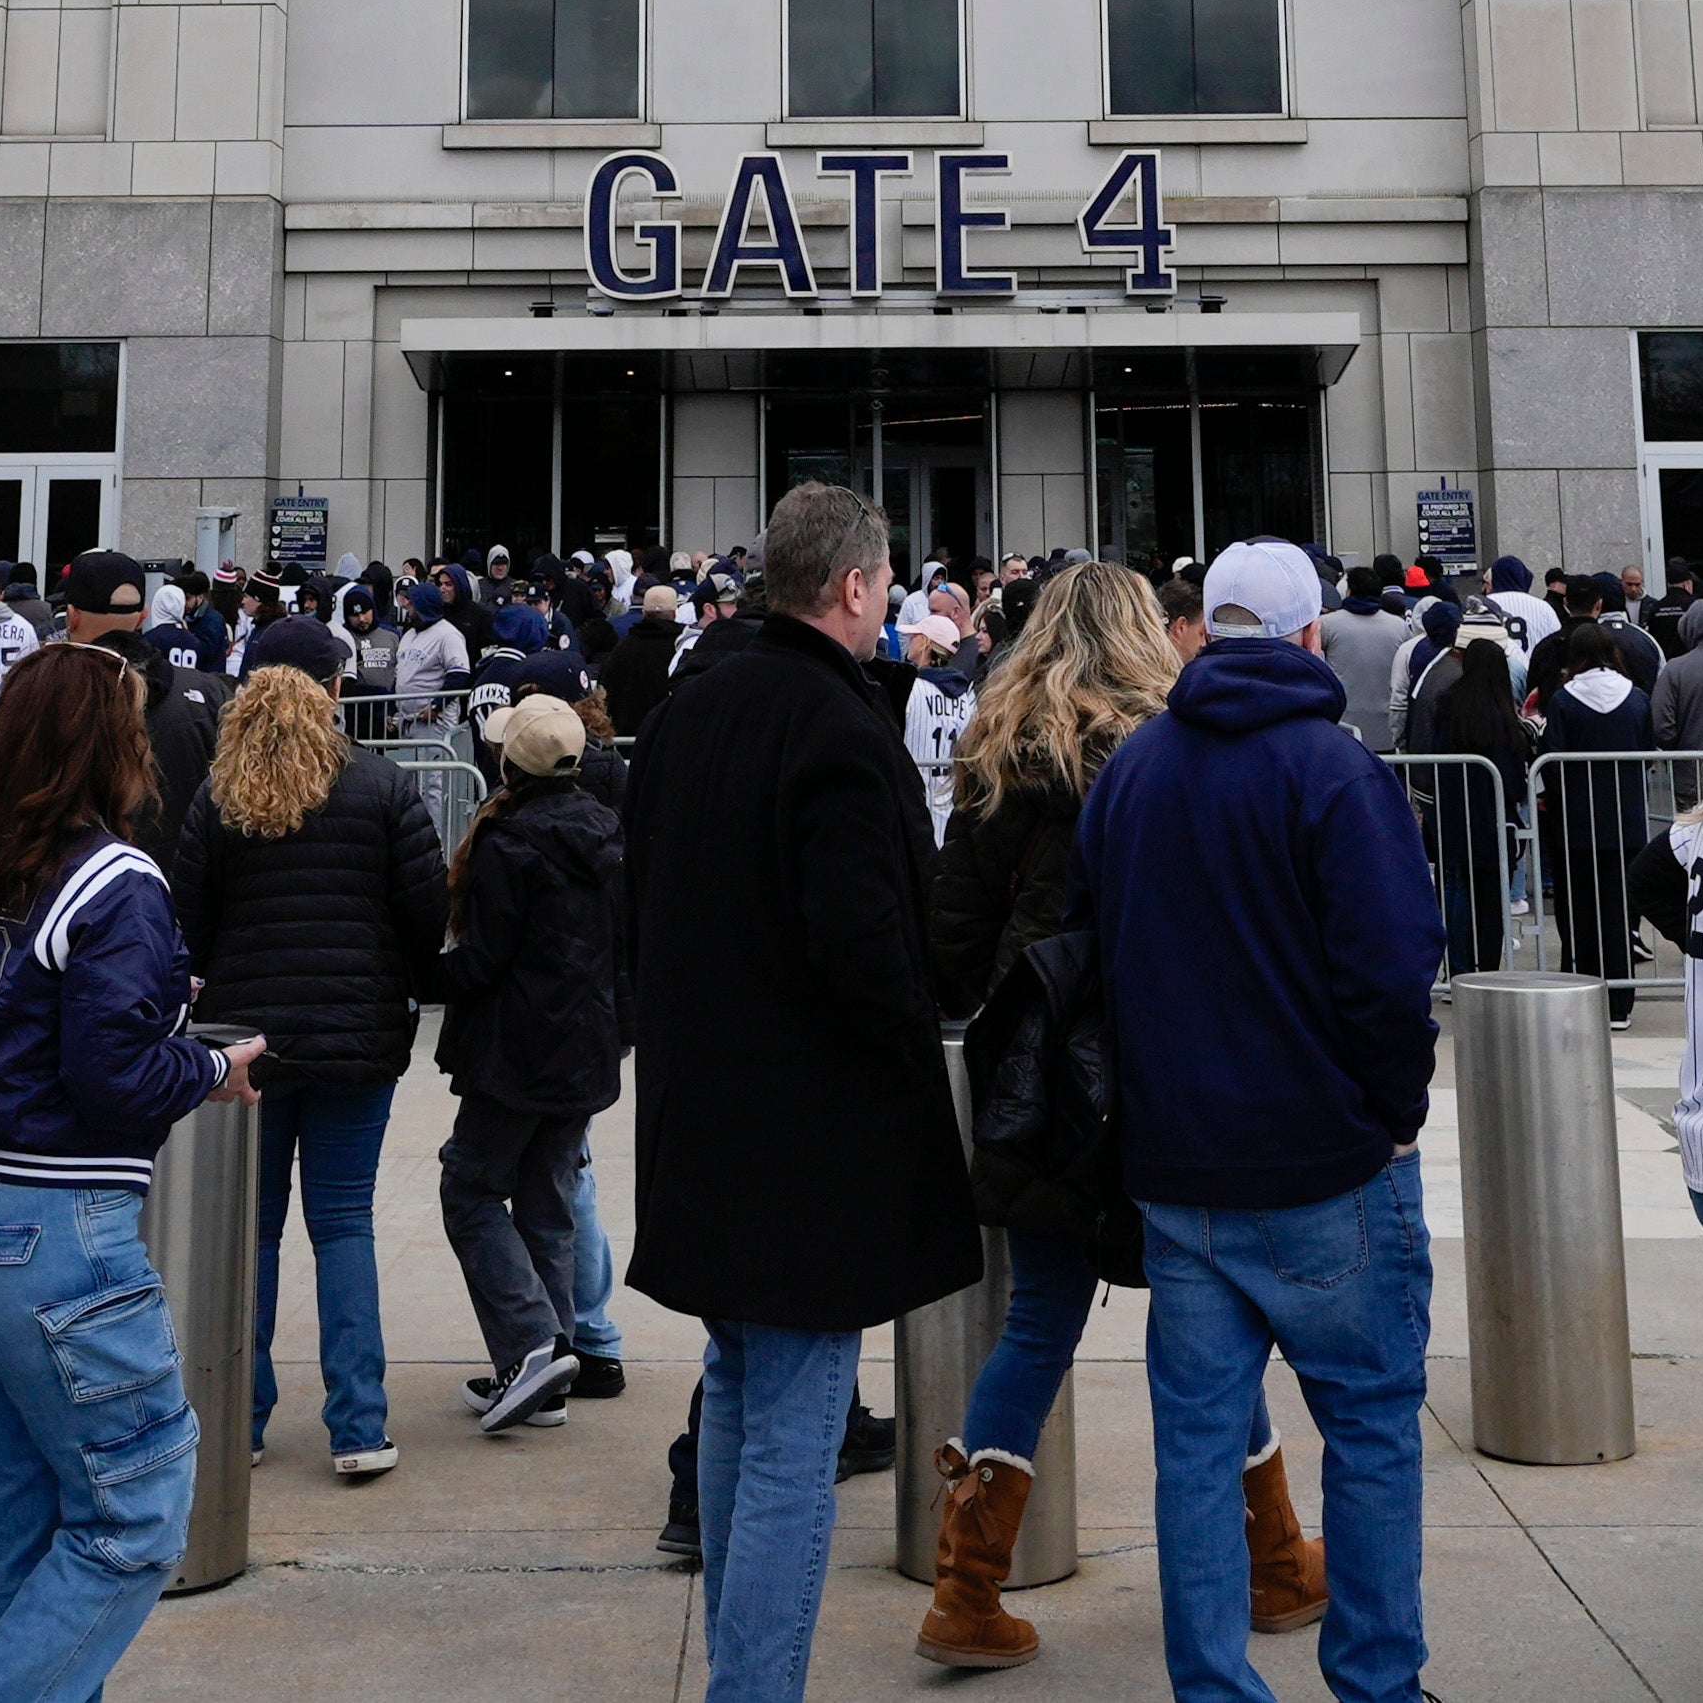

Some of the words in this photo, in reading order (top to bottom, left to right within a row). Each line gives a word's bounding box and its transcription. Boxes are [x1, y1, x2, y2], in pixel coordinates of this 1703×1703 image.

[584, 149, 1018, 301] GATE
[1075, 148, 1178, 299] 4
[273, 498, 296, 507] GATE
[298, 497, 326, 507] ENTRY
[1418, 491, 1439, 501] GATE
[1441, 490, 1470, 500] ENTRY
[925, 694, 966, 721] VOLPE
